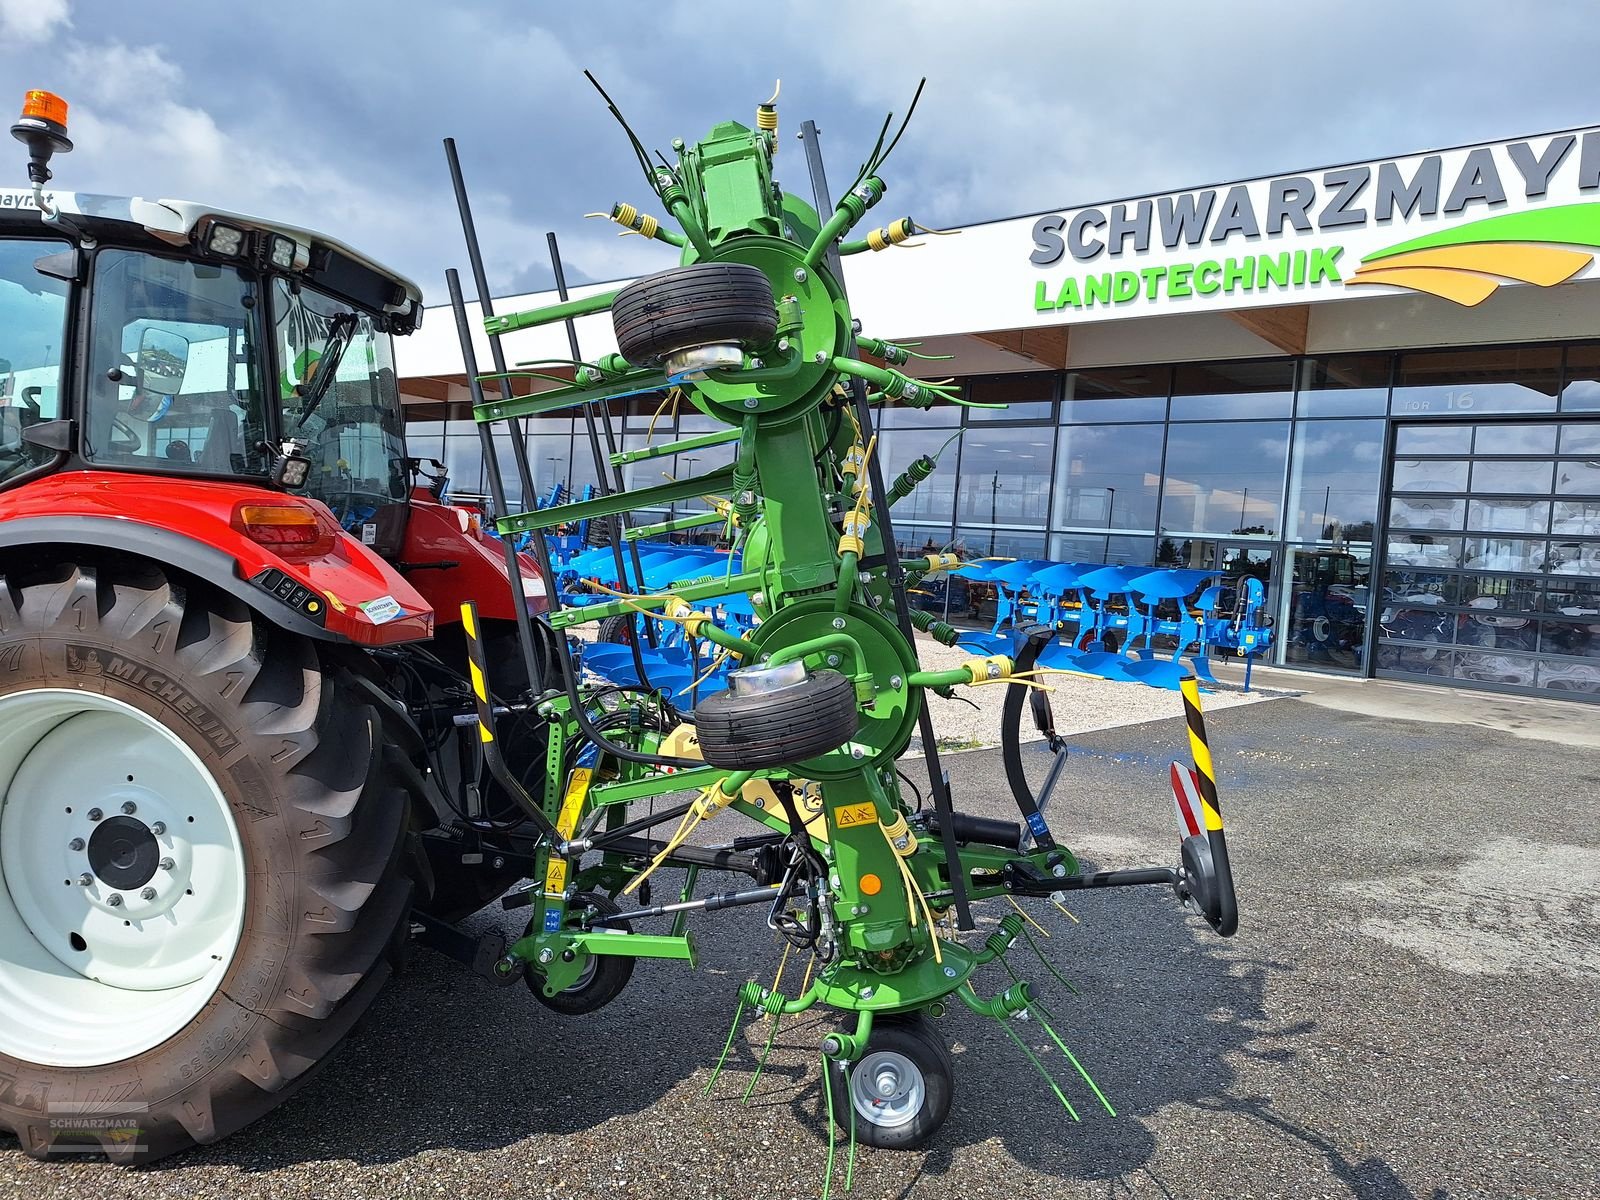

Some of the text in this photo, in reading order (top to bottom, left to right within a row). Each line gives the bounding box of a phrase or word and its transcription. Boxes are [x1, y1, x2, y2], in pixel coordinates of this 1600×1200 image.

[1035, 246, 1344, 310] LANDTECHNIK
[1404, 391, 1475, 411] TOR 16
[106, 657, 234, 749] MICHELIN
